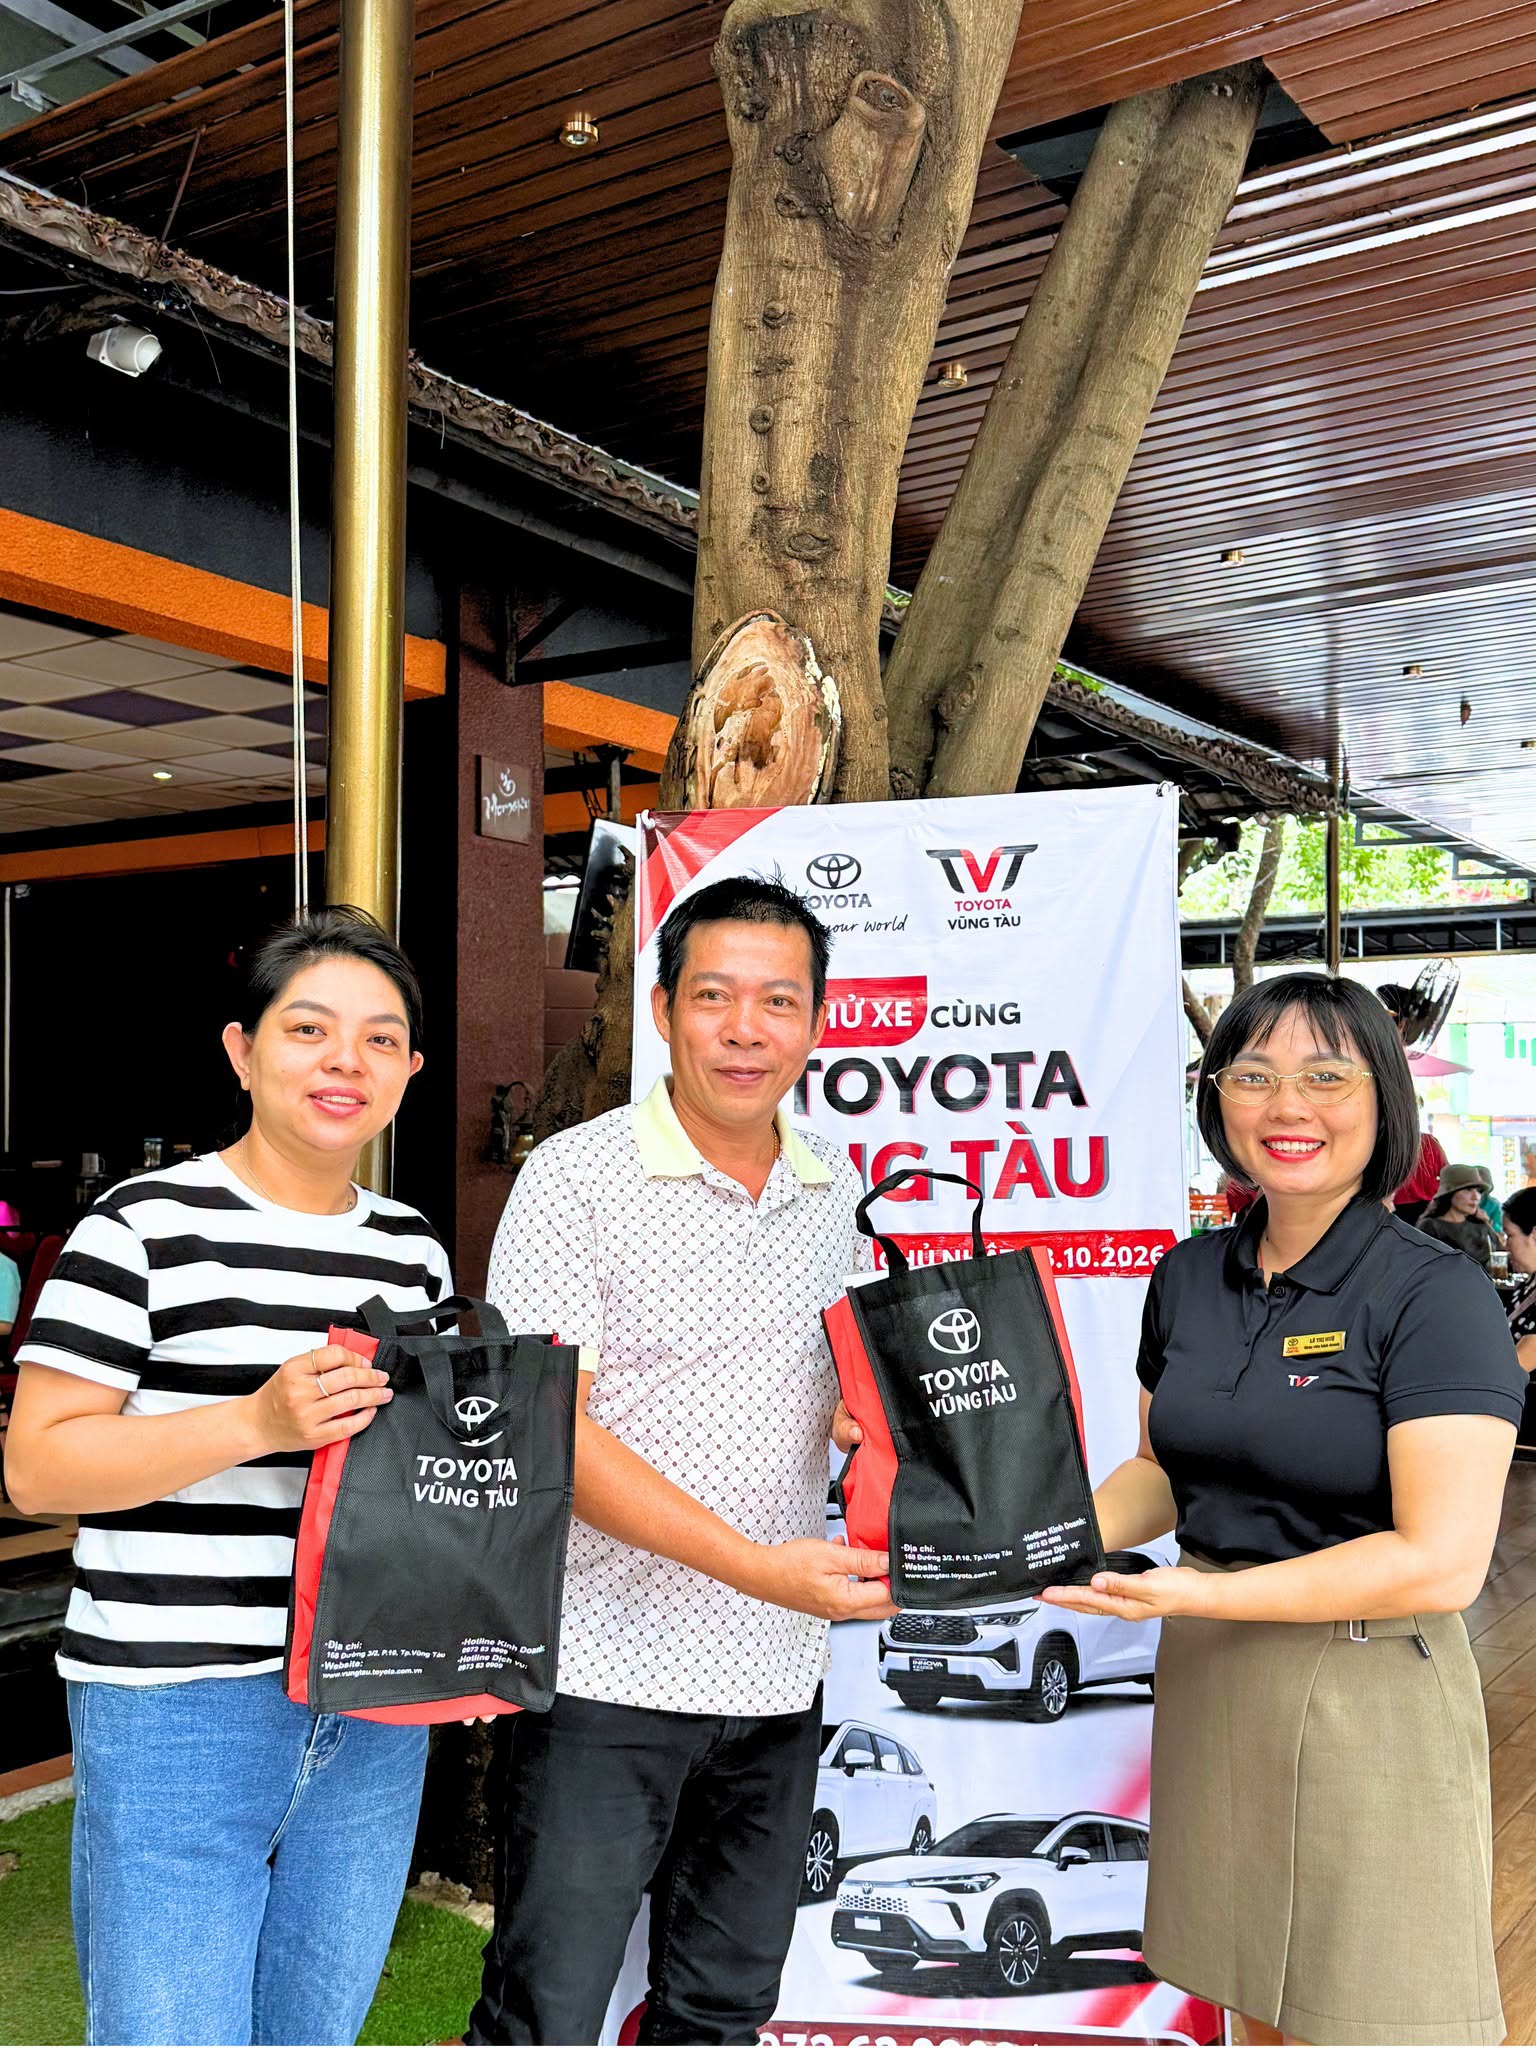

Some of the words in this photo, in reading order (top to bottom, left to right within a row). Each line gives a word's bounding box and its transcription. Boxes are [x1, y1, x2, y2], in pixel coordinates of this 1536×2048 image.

[954, 898, 1012, 912] TOYOTA
[864, 914, 909, 933] world
[948, 914, 989, 930] VŨNG
[995, 913, 1021, 928] TÀU
[871, 1001, 913, 1027] XE
[930, 998, 1021, 1028] CÙNG
[793, 1050, 1089, 1116] TOYOTA
[950, 1121, 1109, 1201] TÀU
[919, 1359, 1010, 1394] TOYOTA
[929, 1391, 982, 1418] VŨNG
[982, 1383, 1017, 1407] TÀU
[416, 1455, 518, 1483] TOYOTA
[413, 1481, 479, 1508] VŨNG
[485, 1484, 519, 1509] TÀU
